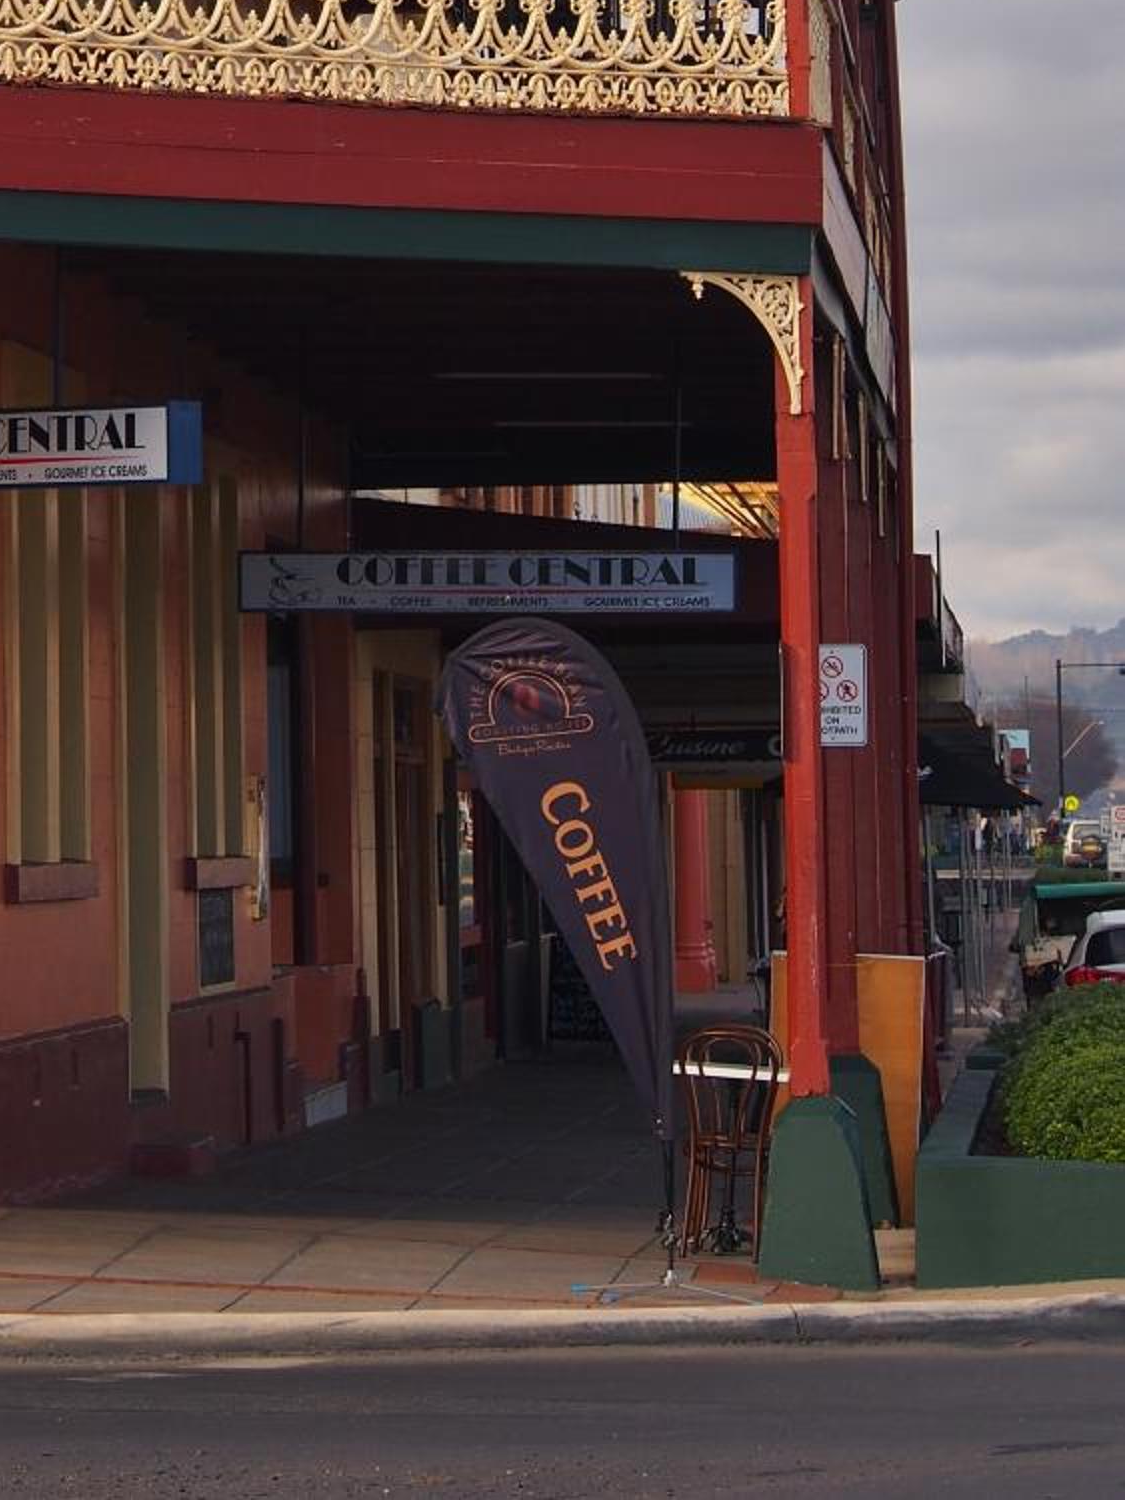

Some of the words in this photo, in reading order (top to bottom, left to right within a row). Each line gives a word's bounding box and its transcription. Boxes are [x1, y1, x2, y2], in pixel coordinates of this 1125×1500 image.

[43, 466, 90, 480] GOURMET
[90, 465, 108, 479] ICE
[109, 463, 149, 478] CREAMS
[335, 556, 501, 587] COFFEE
[507, 555, 711, 587] CENTRAL
[336, 596, 357, 607] TEA
[389, 595, 433, 607] COFFEE
[467, 595, 549, 607] REFRESHMENTS
[583, 595, 640, 607] GOURMET
[663, 594, 711, 607] CREAMS
[469, 683, 486, 720] THE
[540, 780, 638, 973] COFFEE
